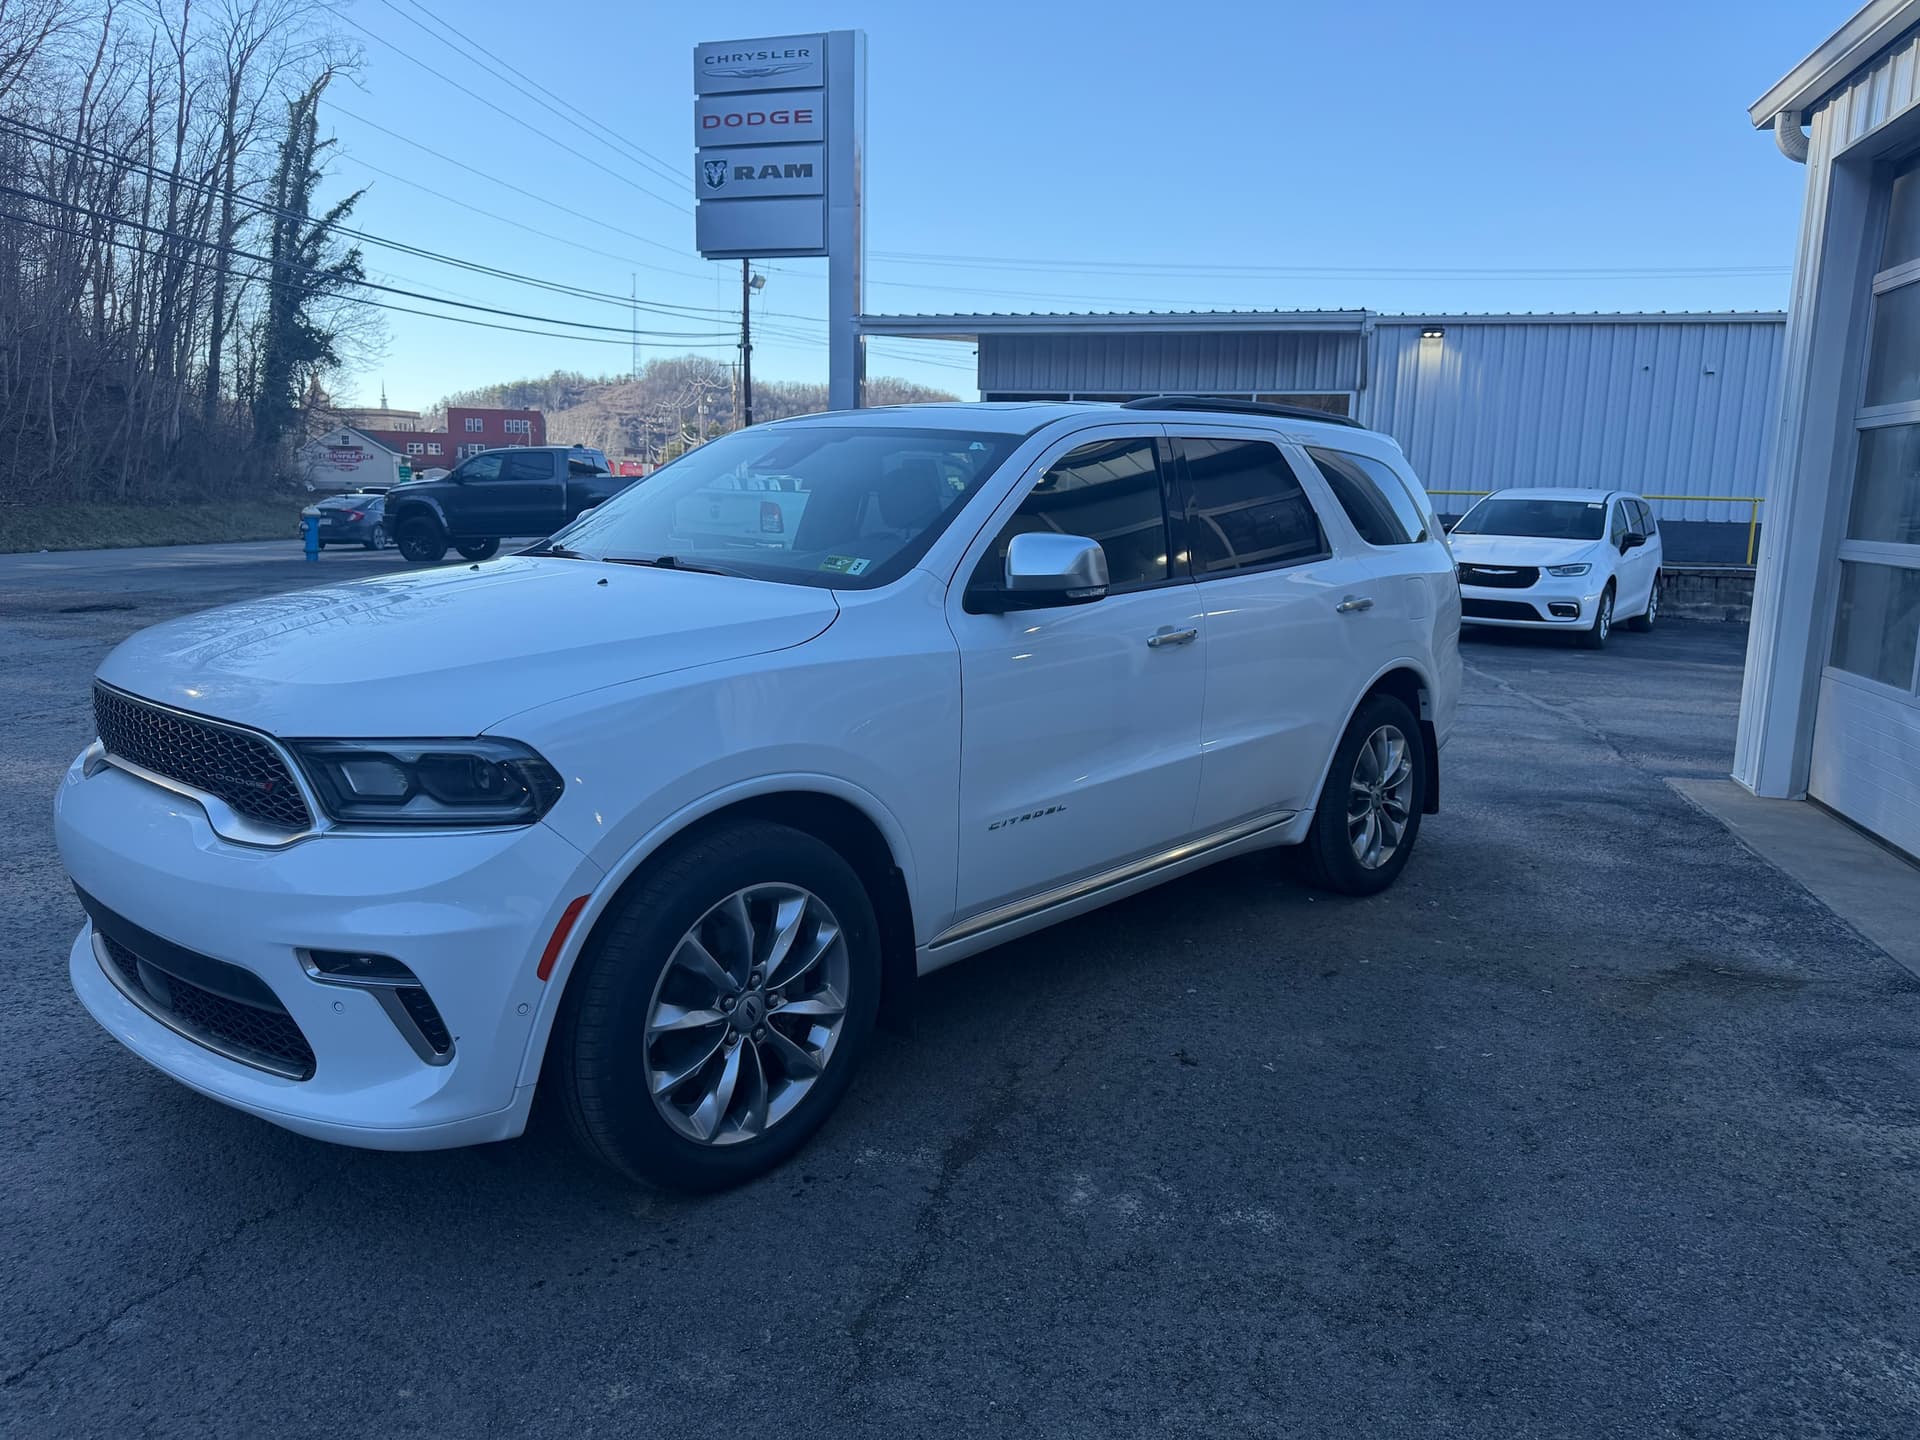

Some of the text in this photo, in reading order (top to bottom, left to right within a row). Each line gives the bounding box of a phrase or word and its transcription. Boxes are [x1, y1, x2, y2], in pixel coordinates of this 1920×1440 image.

[704, 49, 810, 65] CHRYSLER
[702, 109, 813, 129] DODGE
[733, 163, 813, 181] RAM
[988, 805, 1067, 831] CITADEL
